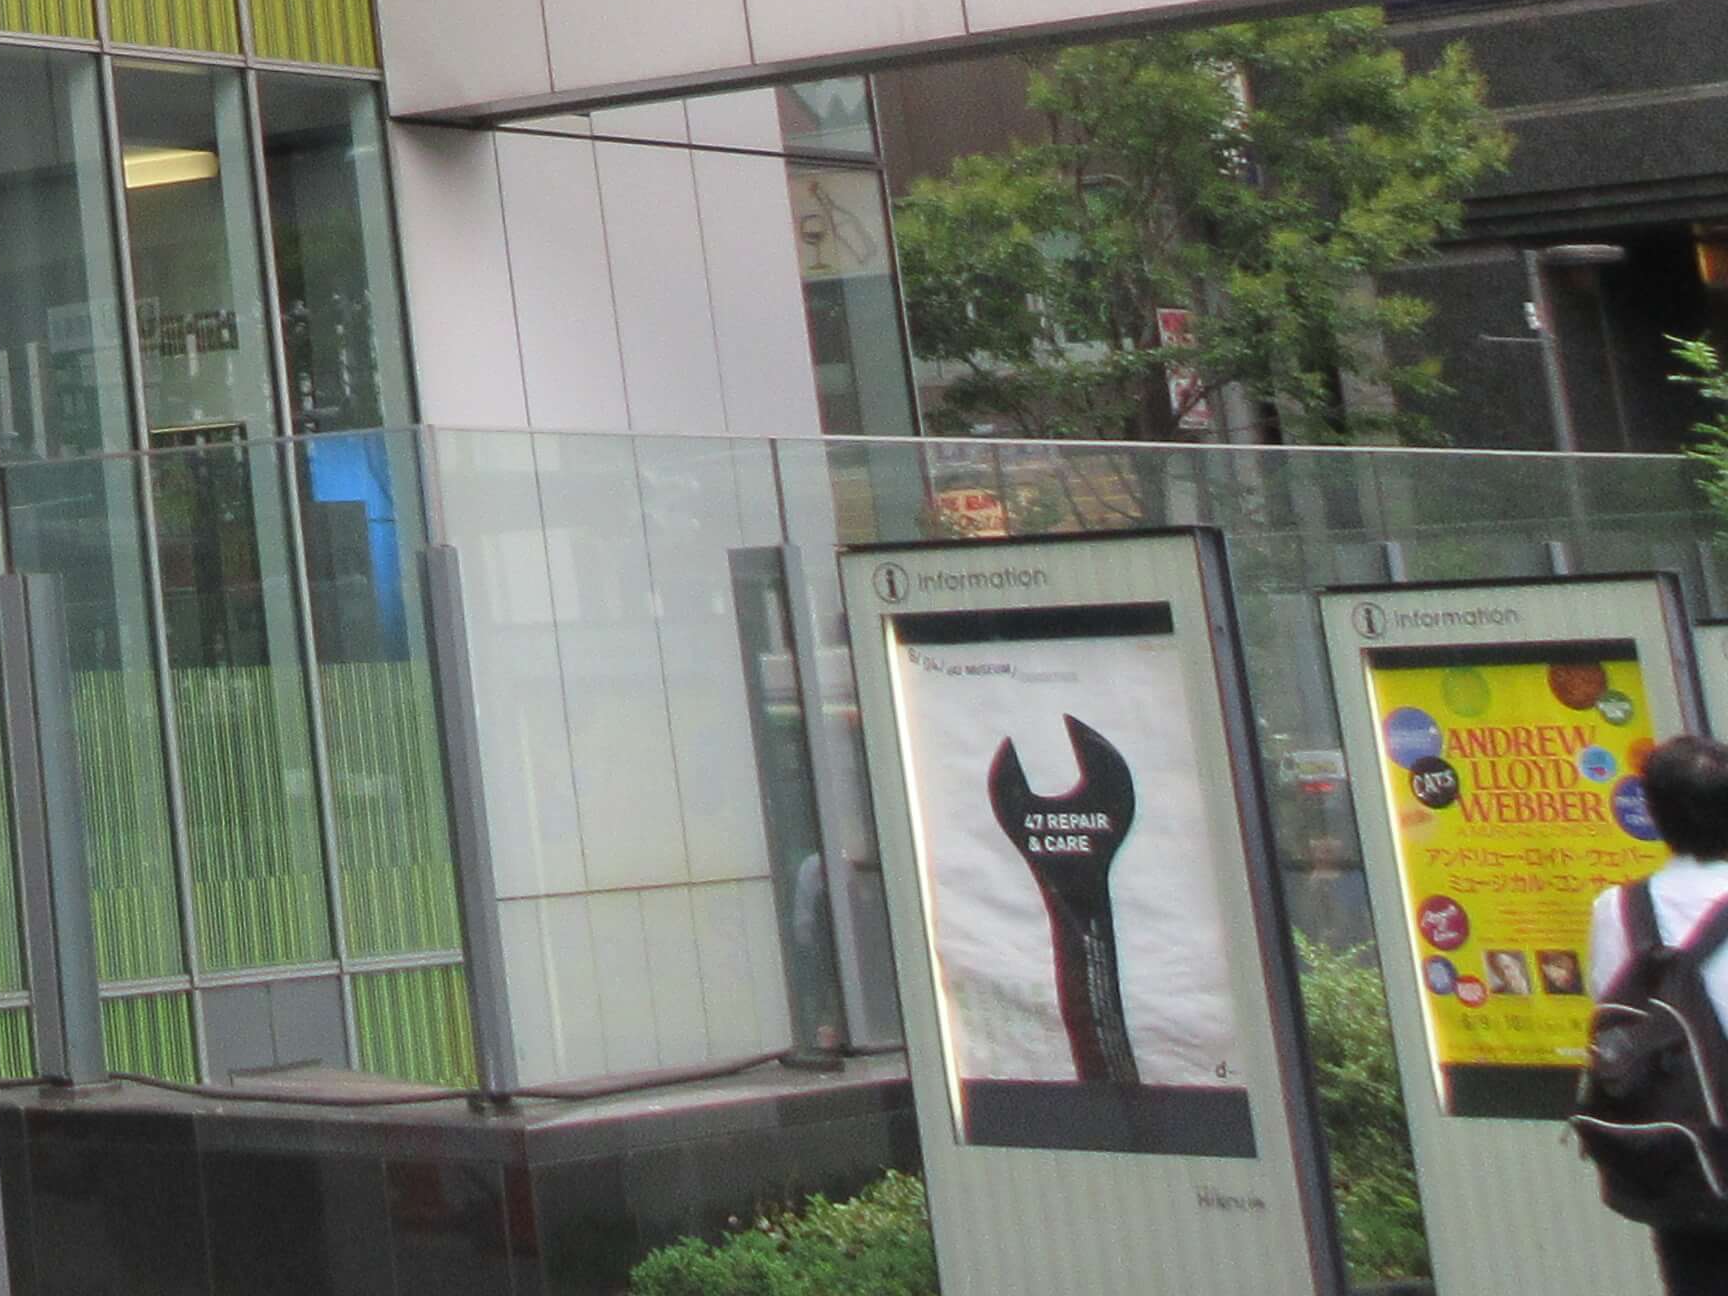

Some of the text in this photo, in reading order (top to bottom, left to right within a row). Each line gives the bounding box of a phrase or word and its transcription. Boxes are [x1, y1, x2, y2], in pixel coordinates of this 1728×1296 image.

[918, 566, 1047, 593] Information
[1394, 606, 1520, 630] Information
[1447, 725, 1594, 758] ANDREW
[1470, 758, 1581, 792] LLOYD
[1024, 812, 1110, 830] 47 REPAIR
[1455, 791, 1611, 825] WEBBER
[1029, 834, 1091, 852] & CARE
